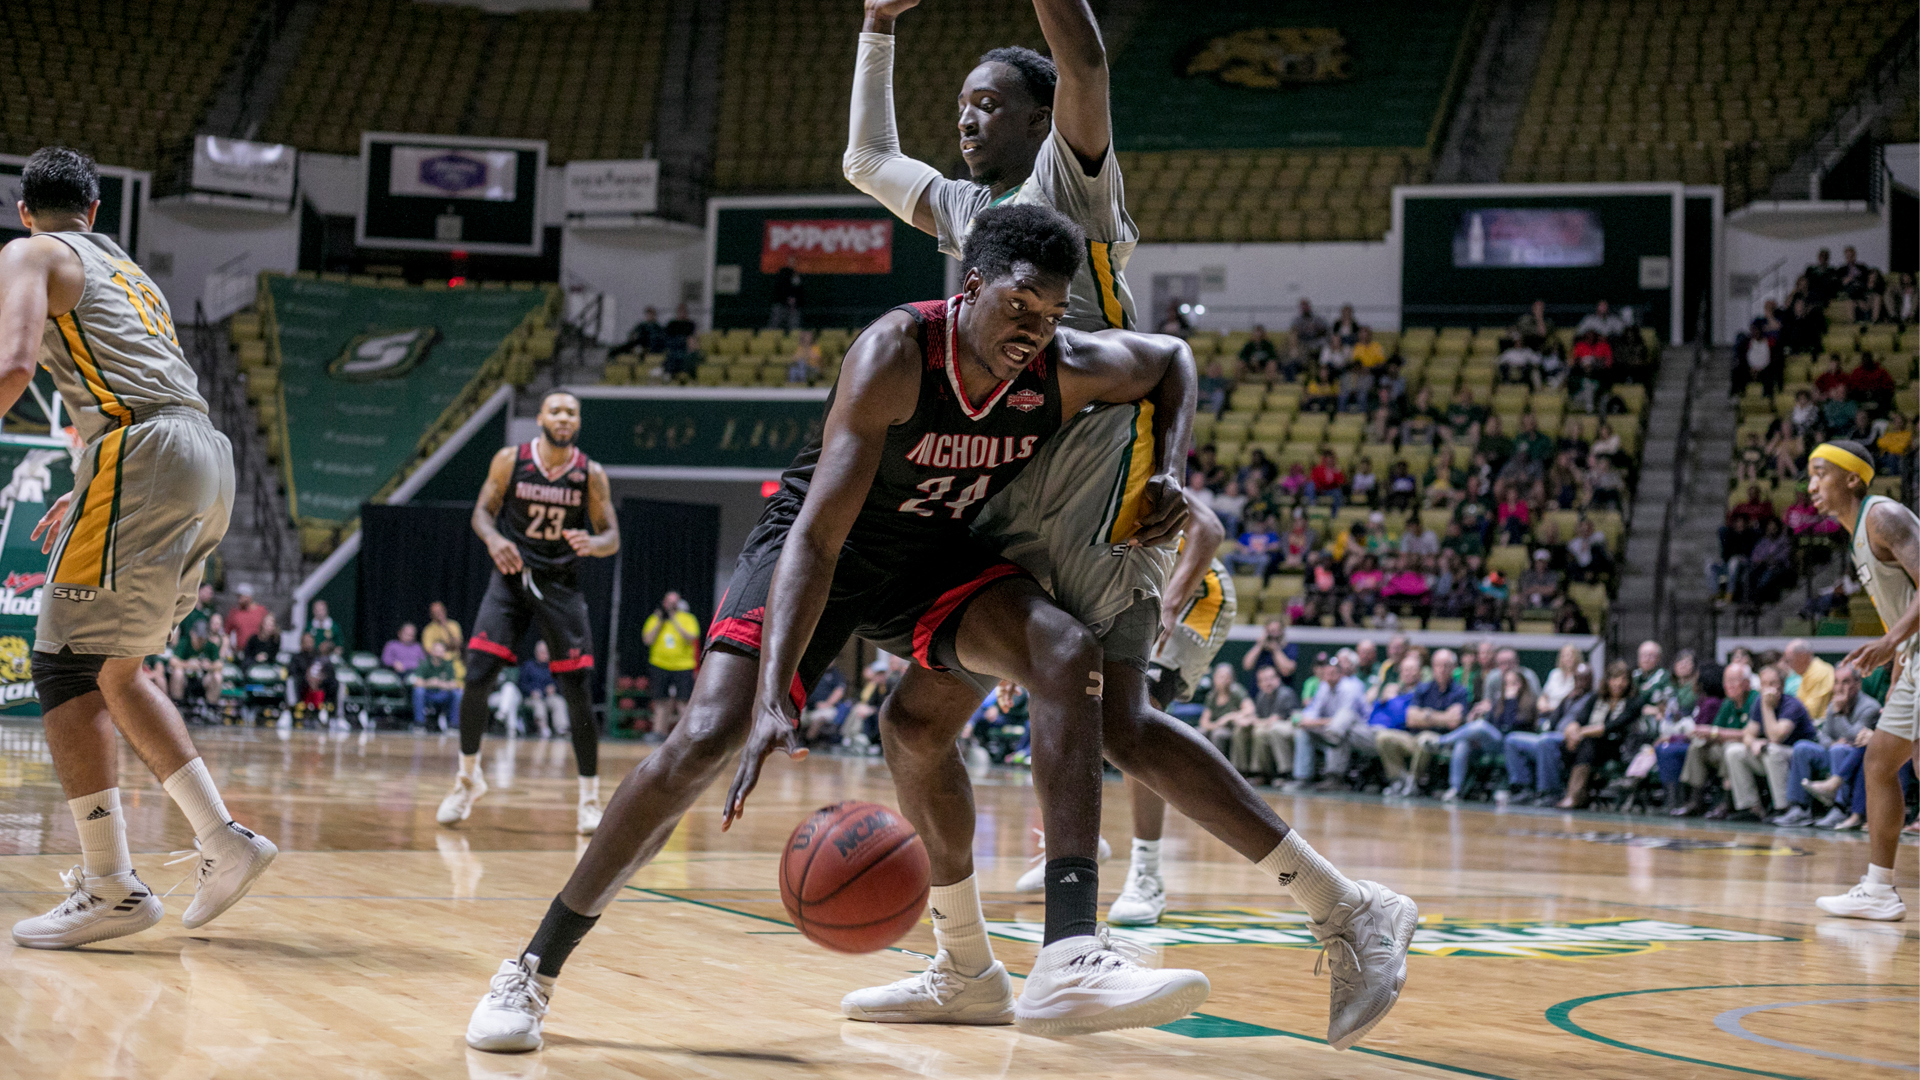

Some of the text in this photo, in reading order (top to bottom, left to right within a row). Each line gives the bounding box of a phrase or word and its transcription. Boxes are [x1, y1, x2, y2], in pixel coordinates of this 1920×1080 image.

[1007, 394, 1044, 405] SOUTHLAND
[905, 432, 1039, 469] NICHOLLS
[515, 482, 582, 507] NICHOLLS
[898, 474, 992, 519] 24
[525, 503, 566, 540] 23
[53, 587, 97, 603] SLU
[833, 810, 898, 858] NCAA
